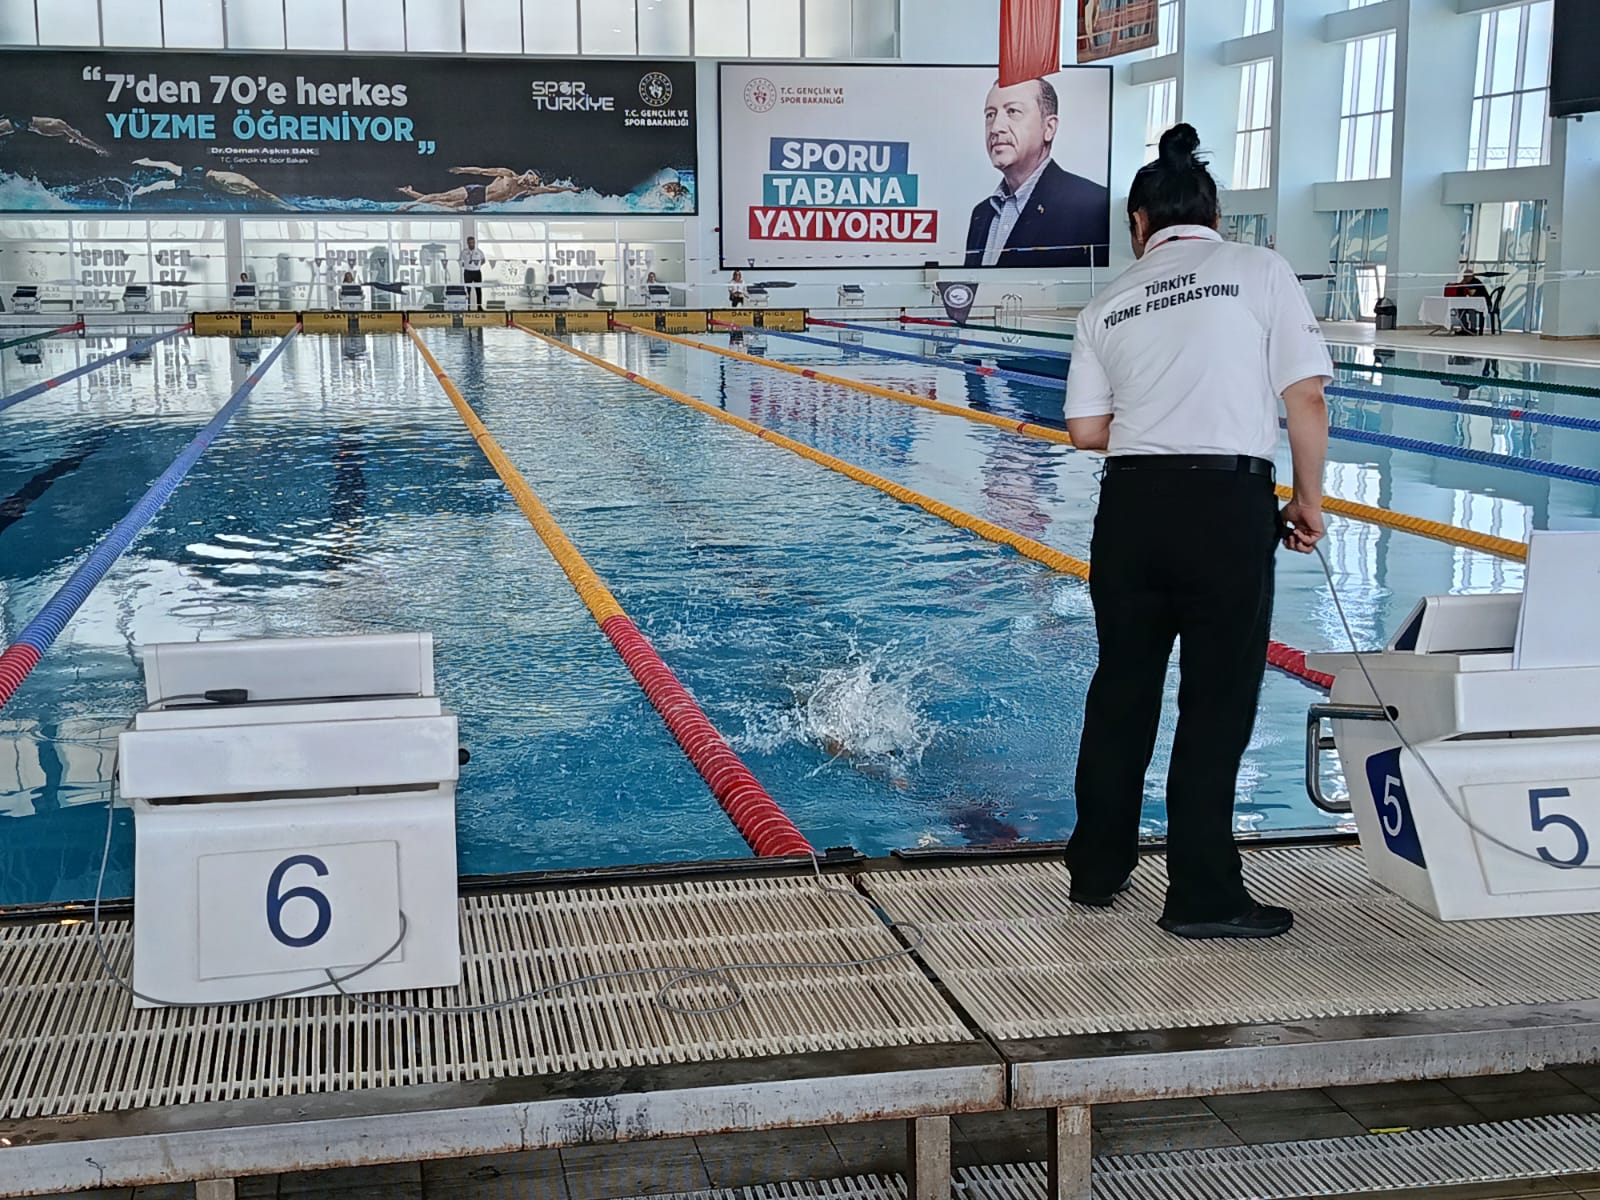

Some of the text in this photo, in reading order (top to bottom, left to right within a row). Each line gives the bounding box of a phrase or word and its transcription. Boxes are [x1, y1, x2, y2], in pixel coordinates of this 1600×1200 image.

[209, 75, 287, 105] 70’e
[296, 76, 408, 107] herkes
[532, 81, 586, 96] SPOR
[780, 85, 844, 96] T.C. GENÇLİK VE
[780, 95, 844, 105] SPOR BAKANLIĞI
[532, 94, 615, 111] TÜRKİYE
[624, 109, 689, 119] T.C. GENÇLİK VE
[105, 107, 216, 140] YÜZME
[624, 118, 689, 127] SPOR BAKANLIĞI
[292, 147, 315, 155] BAK
[781, 141, 891, 172] SPORU
[772, 176, 905, 206] TABANA
[754, 209, 932, 240] YAYIYORUZ
[80, 249, 126, 267] SPOR
[556, 250, 596, 266] SPOR
[1145, 273, 1197, 297] TÜRKİYE
[1103, 284, 1239, 330] YÜZME FEDERASYONU
[1382, 775, 1403, 838] 5
[1528, 787, 1589, 870] 5
[266, 854, 332, 947] 6
